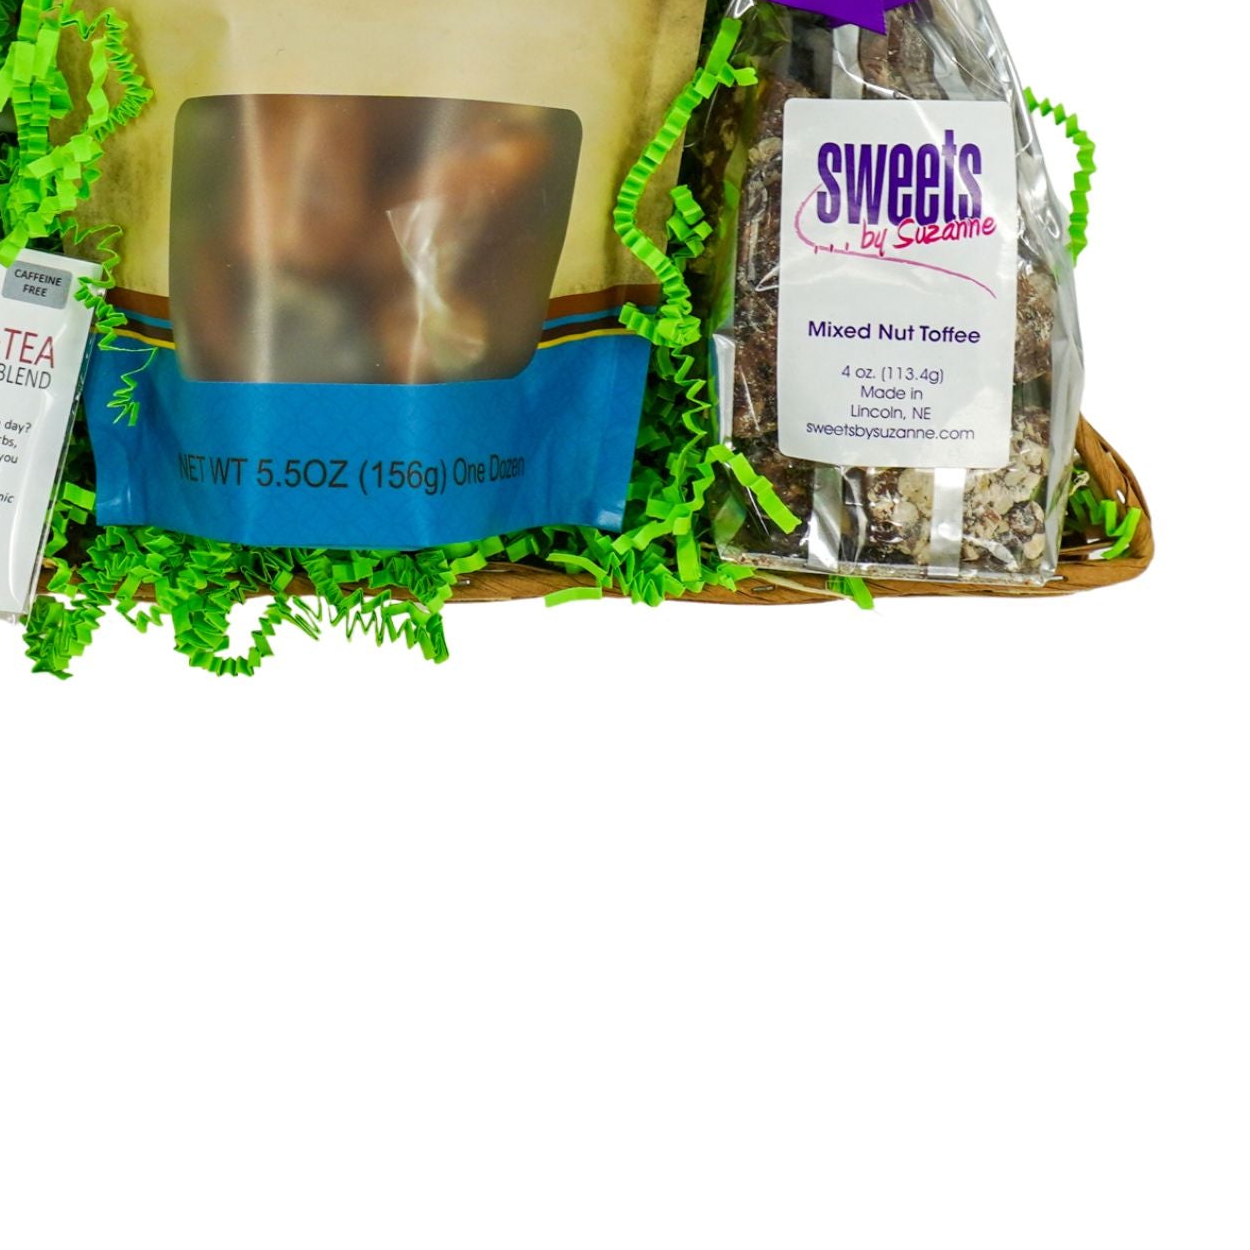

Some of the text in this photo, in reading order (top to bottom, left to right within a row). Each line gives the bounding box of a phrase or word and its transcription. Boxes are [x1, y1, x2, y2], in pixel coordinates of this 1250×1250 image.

[817, 129, 982, 226] sweets
[860, 217, 996, 257] by Suzanne
[14, 268, 62, 287] CAFFEINE
[22, 283, 47, 298] FREE
[808, 320, 981, 344] Mixed Nut Toffee
[841, 365, 944, 385] 4 oz. (113.4g)
[860, 385, 923, 400] Made in
[850, 404, 931, 421] Lincoln, NE
[4, 421, 32, 435] day?
[806, 422, 975, 440] sweetsbysuzanne.com
[178, 453, 207, 483] NET
[208, 457, 246, 486] WT
[359, 457, 447, 496] (156g)
[452, 457, 485, 486] One
[489, 454, 526, 481] Dozen
